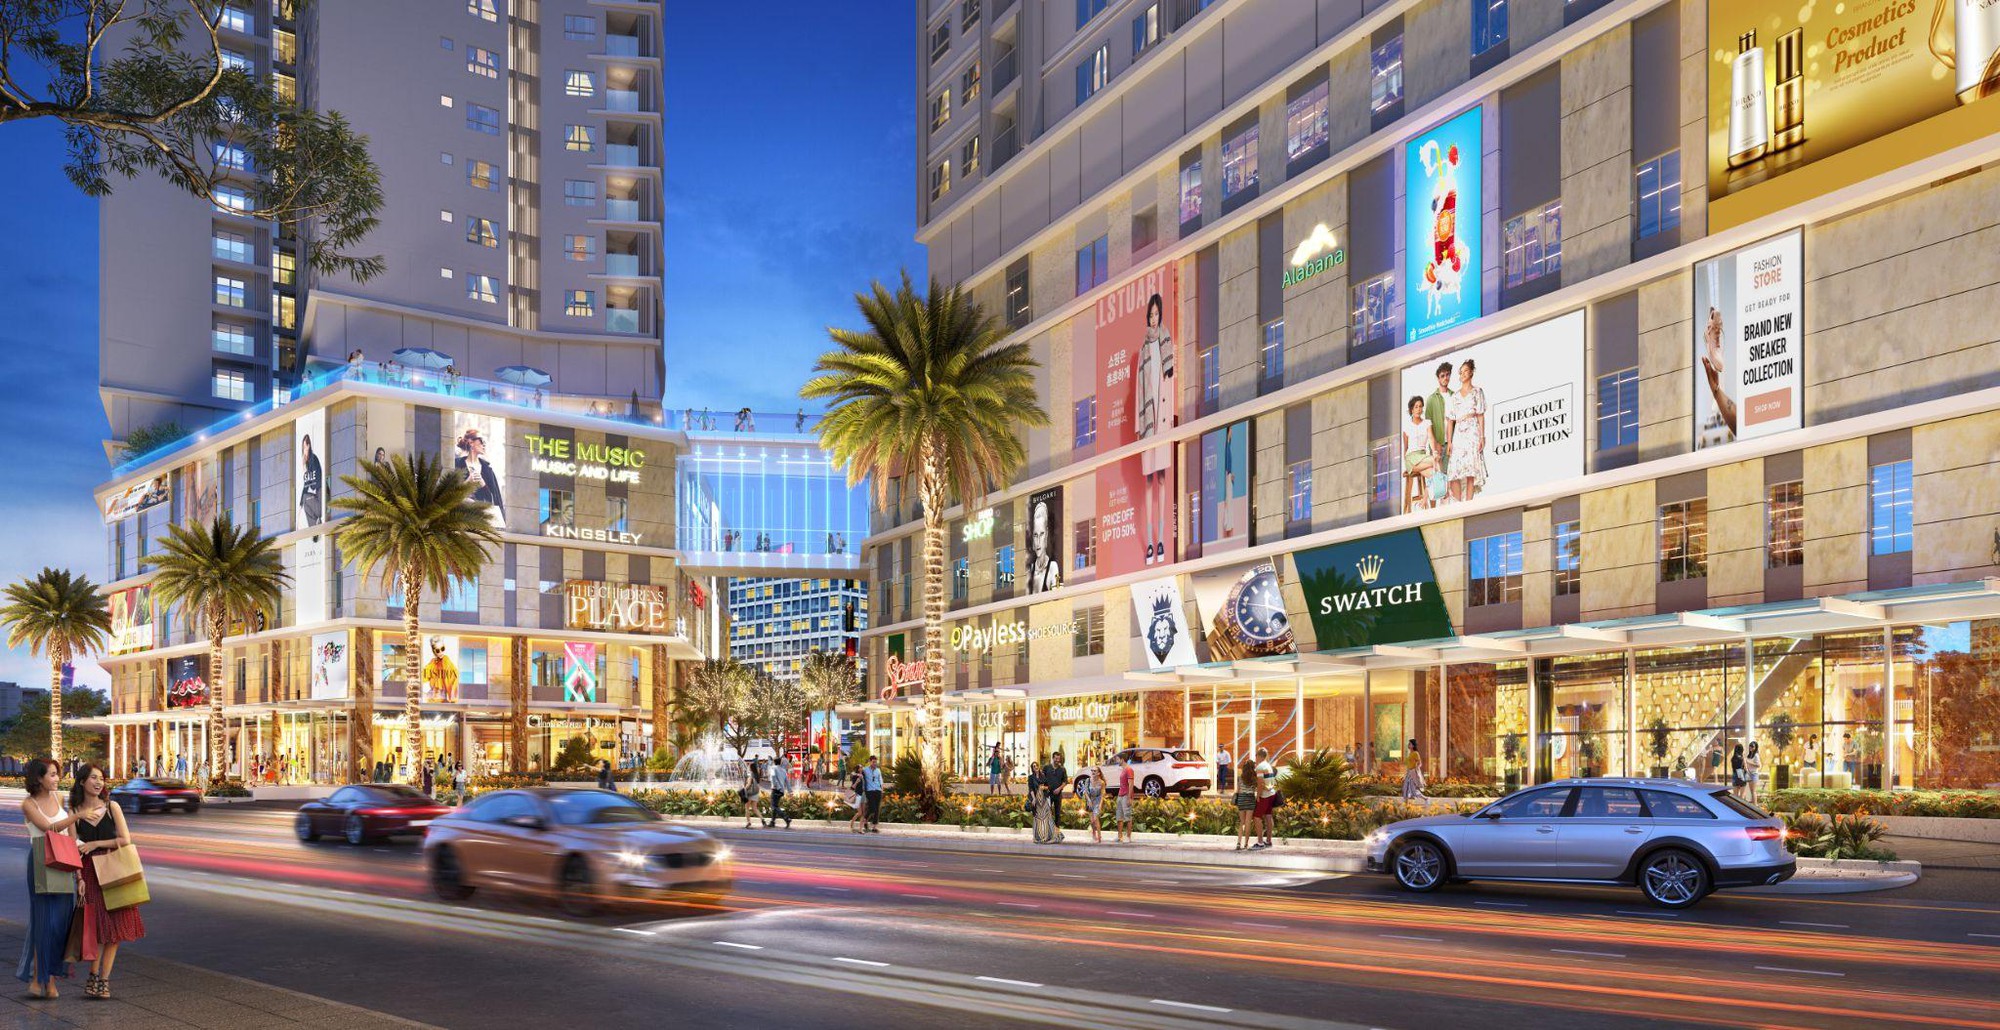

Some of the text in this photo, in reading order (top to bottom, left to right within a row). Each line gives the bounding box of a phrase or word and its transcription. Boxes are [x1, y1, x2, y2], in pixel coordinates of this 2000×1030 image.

[1826, 0, 1916, 50] Cosmetics
[1834, 27, 1906, 74] Product
[1281, 249, 1345, 290] Alabana
[1753, 254, 1782, 272] FASHION
[1753, 267, 1782, 290] STORE
[1095, 266, 1167, 331] LSTUART
[1744, 303, 1756, 313] GET
[1779, 292, 1791, 303] FOR
[1744, 312, 1792, 342] BRAND NEW
[1749, 337, 1787, 362] SNEAKER
[1743, 357, 1793, 386] COLLECTION
[1500, 398, 1565, 425] CHECKOUT
[1497, 412, 1567, 440] THE LATEST
[524, 433, 646, 468] THE MUSIC
[1495, 428, 1570, 456] COLLECTION
[531, 457, 641, 485] MUSIC AND LIFE
[962, 516, 995, 543] SHOP
[1102, 507, 1135, 527] PRICE OFF
[546, 524, 643, 545] KINGSLEY
[1102, 523, 1136, 543] UP TO 50%
[570, 584, 597, 598] THE
[1320, 582, 1423, 615] SWATCH
[570, 595, 665, 629] PLACE
[962, 619, 1079, 654] Payless SHOESOURCE
[1050, 702, 1112, 722] Grand City
